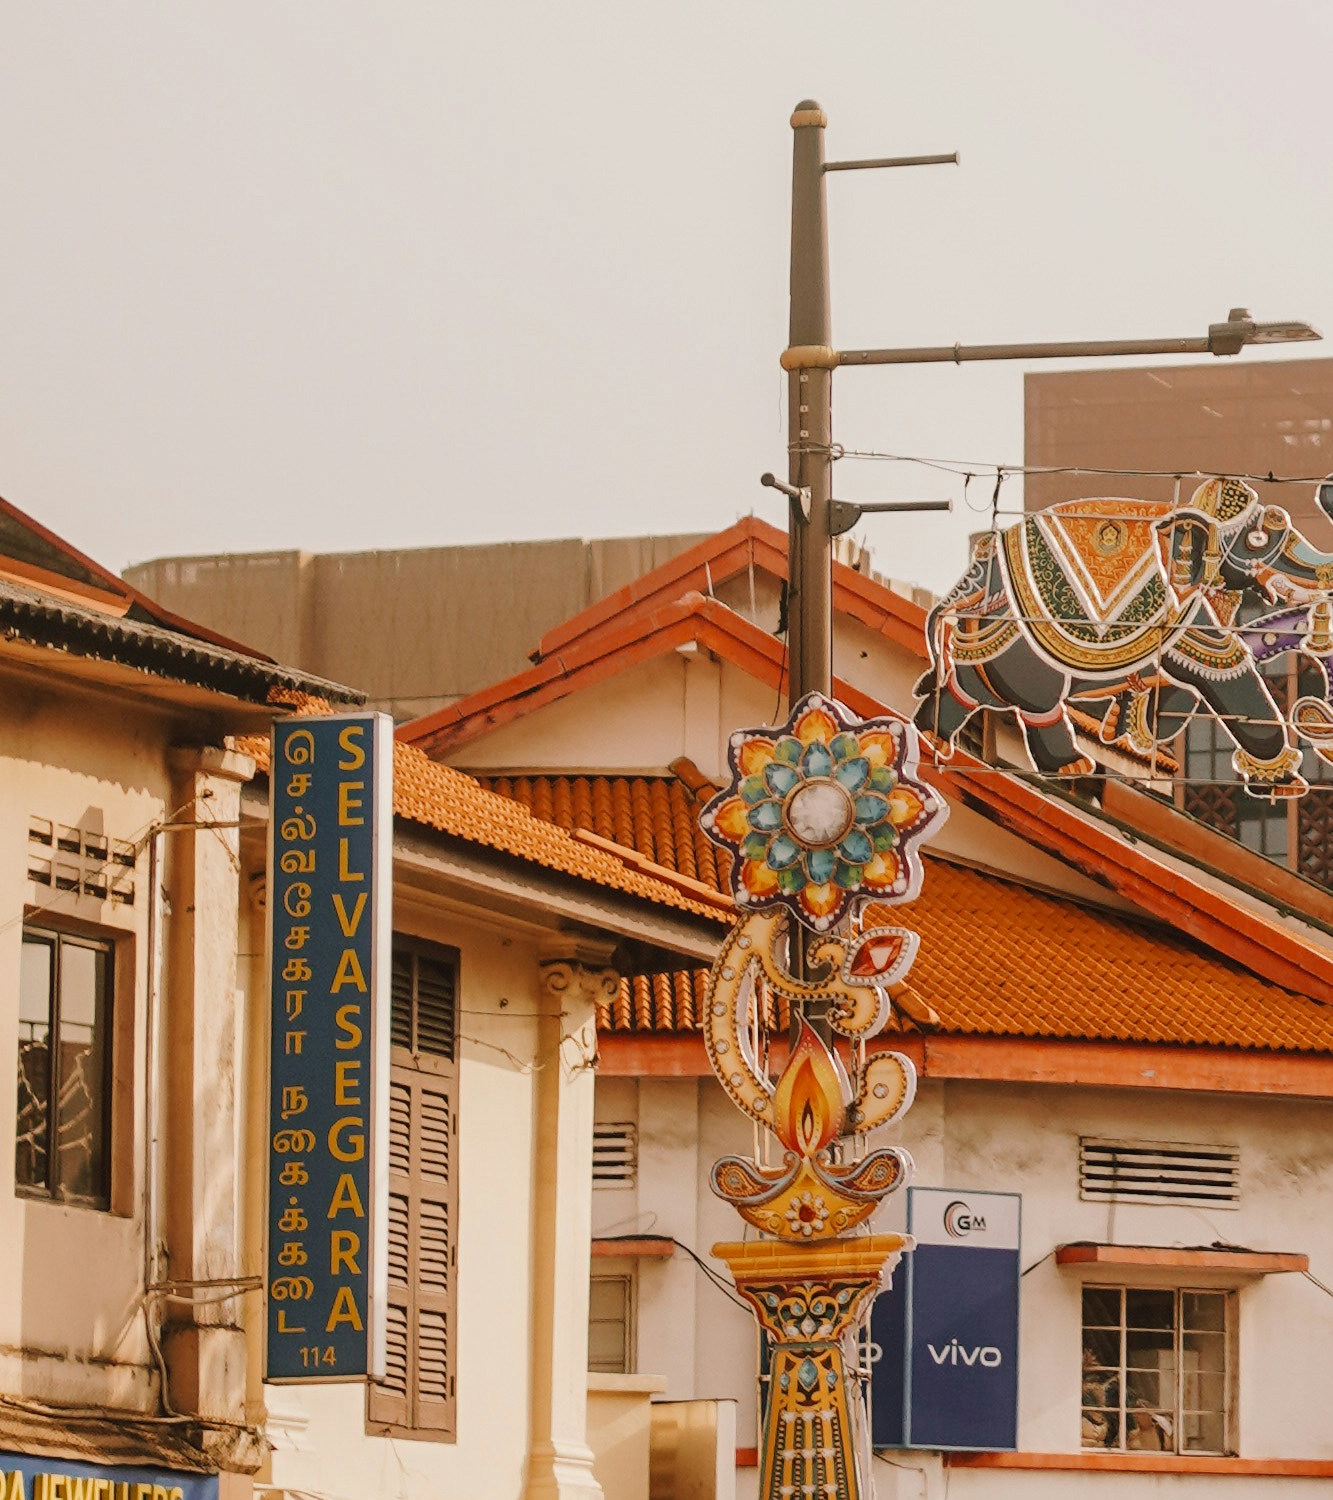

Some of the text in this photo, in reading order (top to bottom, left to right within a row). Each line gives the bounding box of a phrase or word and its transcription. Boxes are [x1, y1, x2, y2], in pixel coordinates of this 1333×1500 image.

[325, 726, 367, 1332] SELVASEGARA
[299, 1346, 336, 1368] 114
[927, 1339, 1002, 1367] vivo
